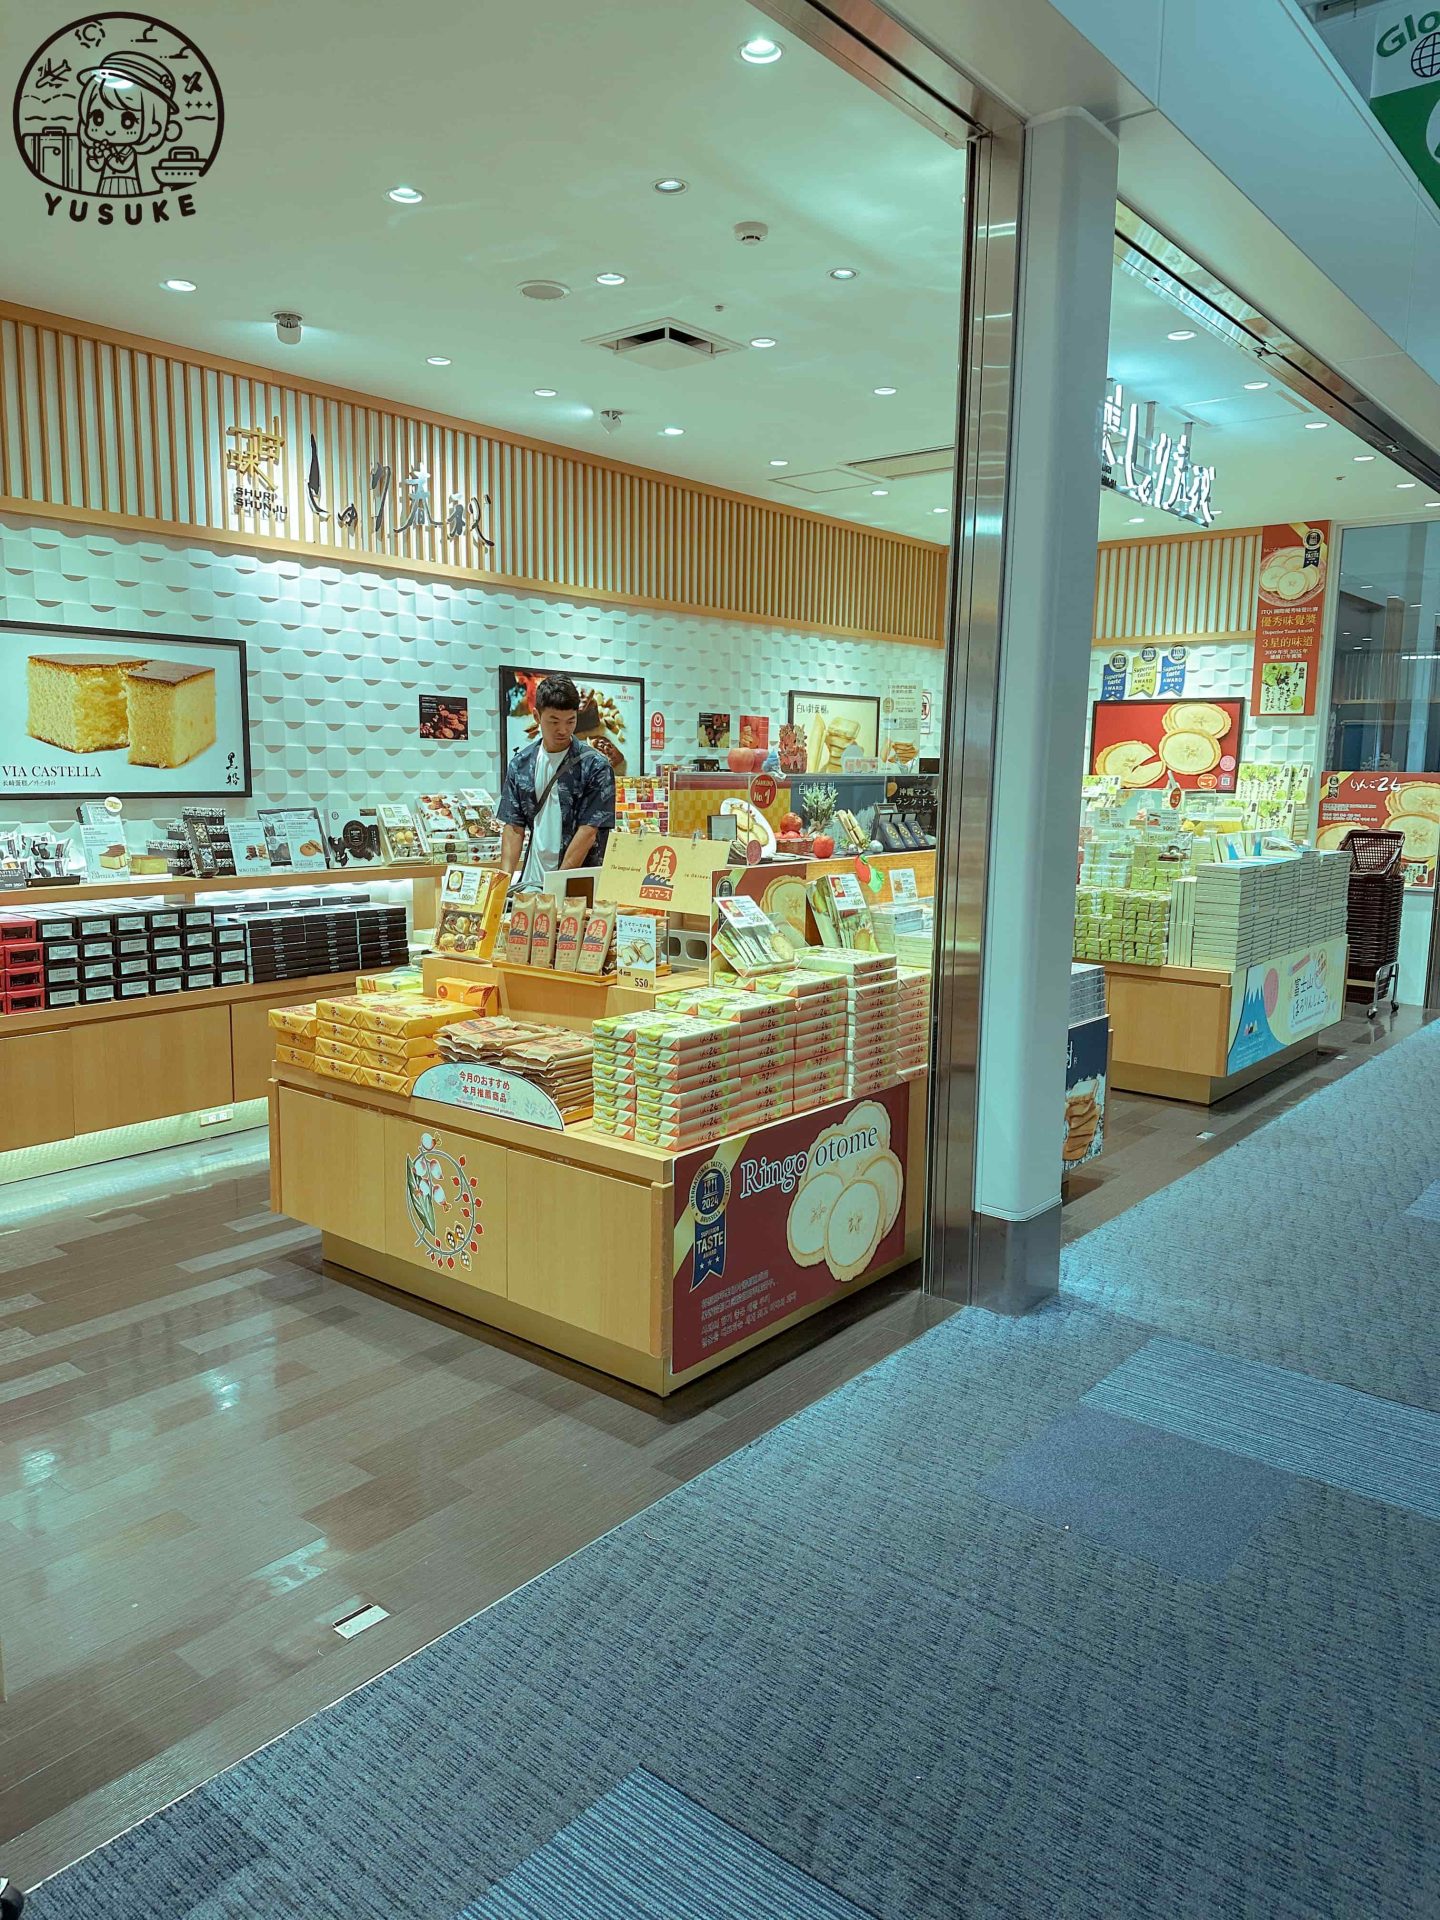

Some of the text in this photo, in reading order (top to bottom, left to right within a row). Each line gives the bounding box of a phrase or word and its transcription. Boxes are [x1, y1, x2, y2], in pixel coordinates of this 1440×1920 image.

[235, 486, 276, 503] SHURI
[235, 498, 288, 514] SHUNJU
[1262, 636, 1313, 648] 3星的味道
[2, 766, 102, 777] VIA CASTELLA
[641, 888, 671, 900] シママース
[459, 1070, 510, 1091] 今月のおすすめ
[462, 1085, 507, 1103] 本月推薦商品
[740, 1126, 878, 1199] Ringo otome
[701, 1197, 719, 1212] 2024
[700, 1209, 721, 1223] BRUSSELS
[696, 1231, 724, 1255] TASTE
[702, 1248, 717, 1260] AWARD
